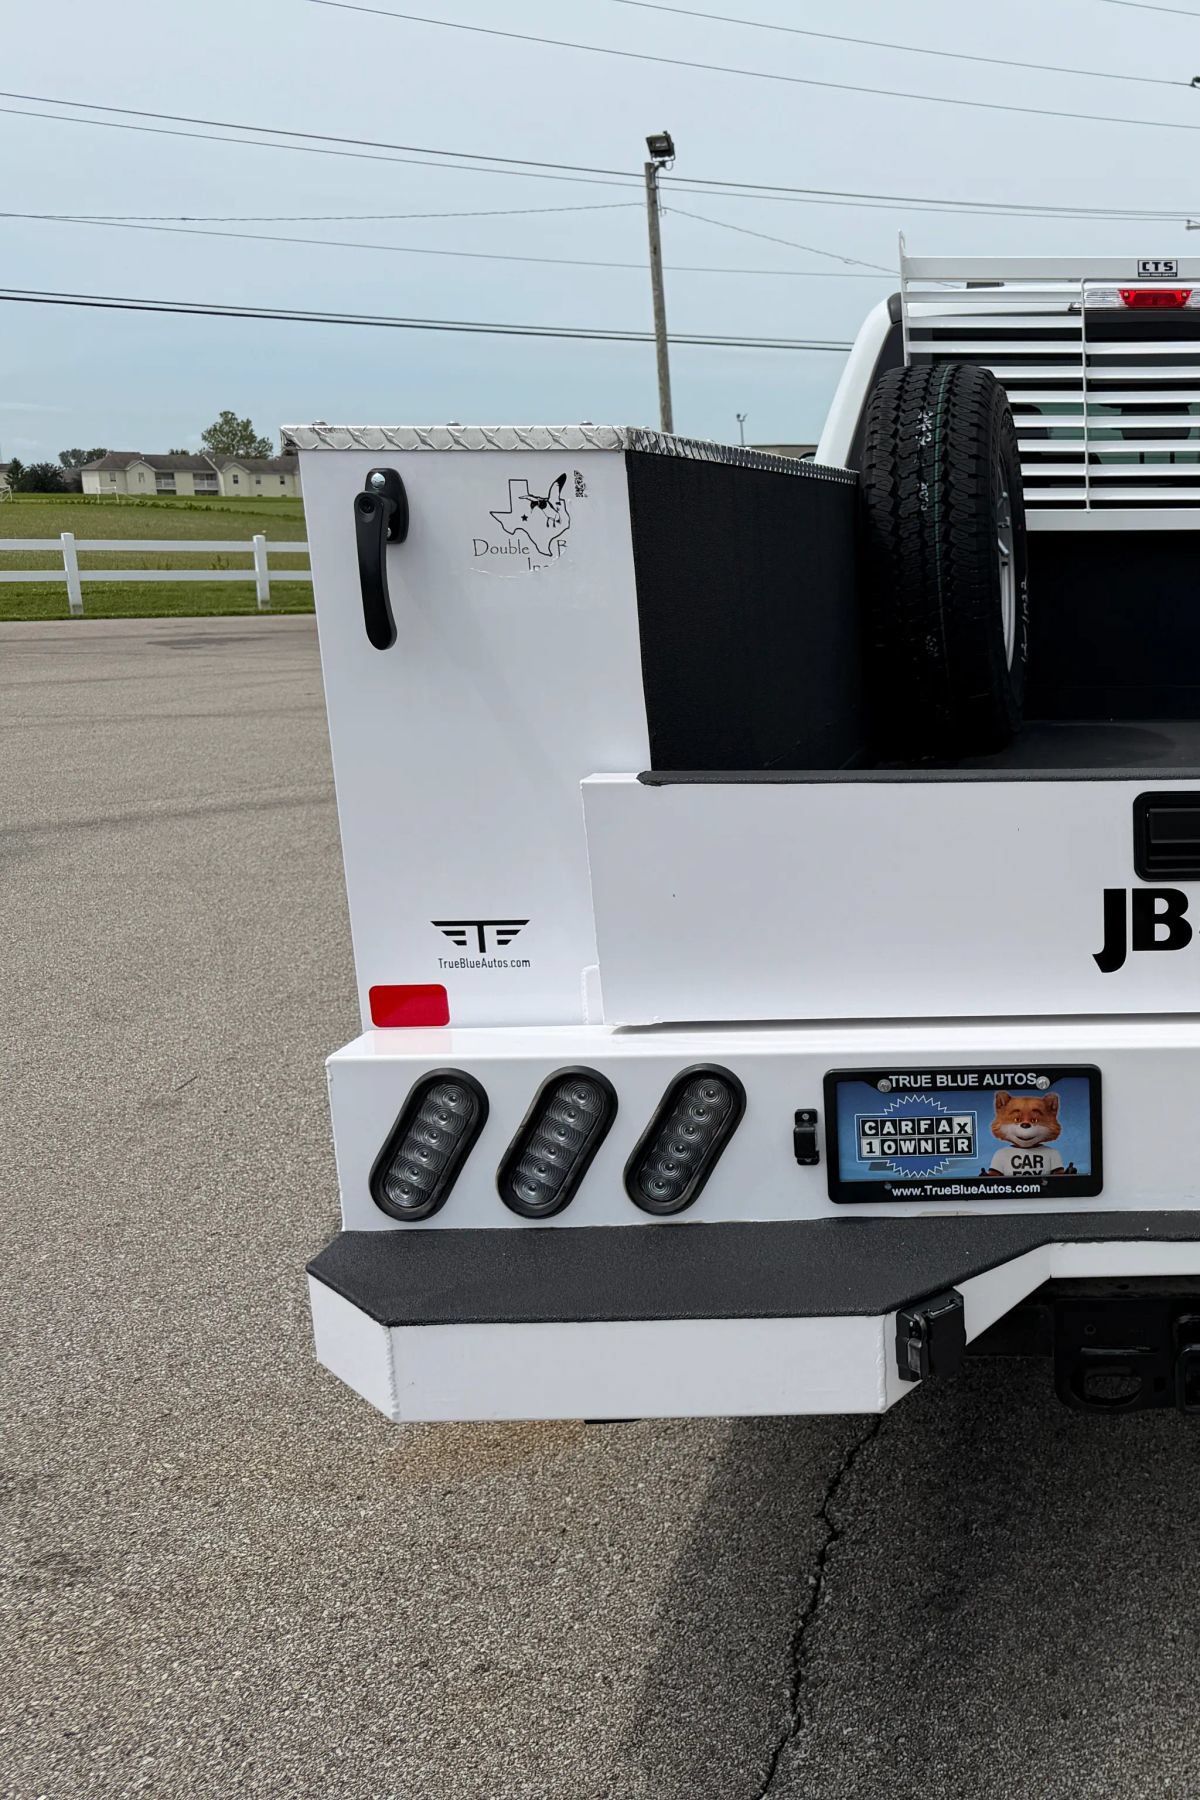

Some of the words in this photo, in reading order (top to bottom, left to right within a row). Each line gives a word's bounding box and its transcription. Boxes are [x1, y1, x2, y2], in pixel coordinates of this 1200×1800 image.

[1142, 261, 1173, 271] CTS
[473, 538, 530, 556] Double
[1092, 888, 1193, 973] JB
[438, 957, 531, 969] TrueBlueAutos.com
[889, 1075, 932, 1088] TRUE
[936, 1074, 979, 1087] BLUE
[983, 1073, 1037, 1086] AUTOS
[863, 1119, 970, 1136] CARFAX
[1011, 1154, 1044, 1169] CAR
[891, 1183, 1041, 1197] www.TrueBlueAutos.com
